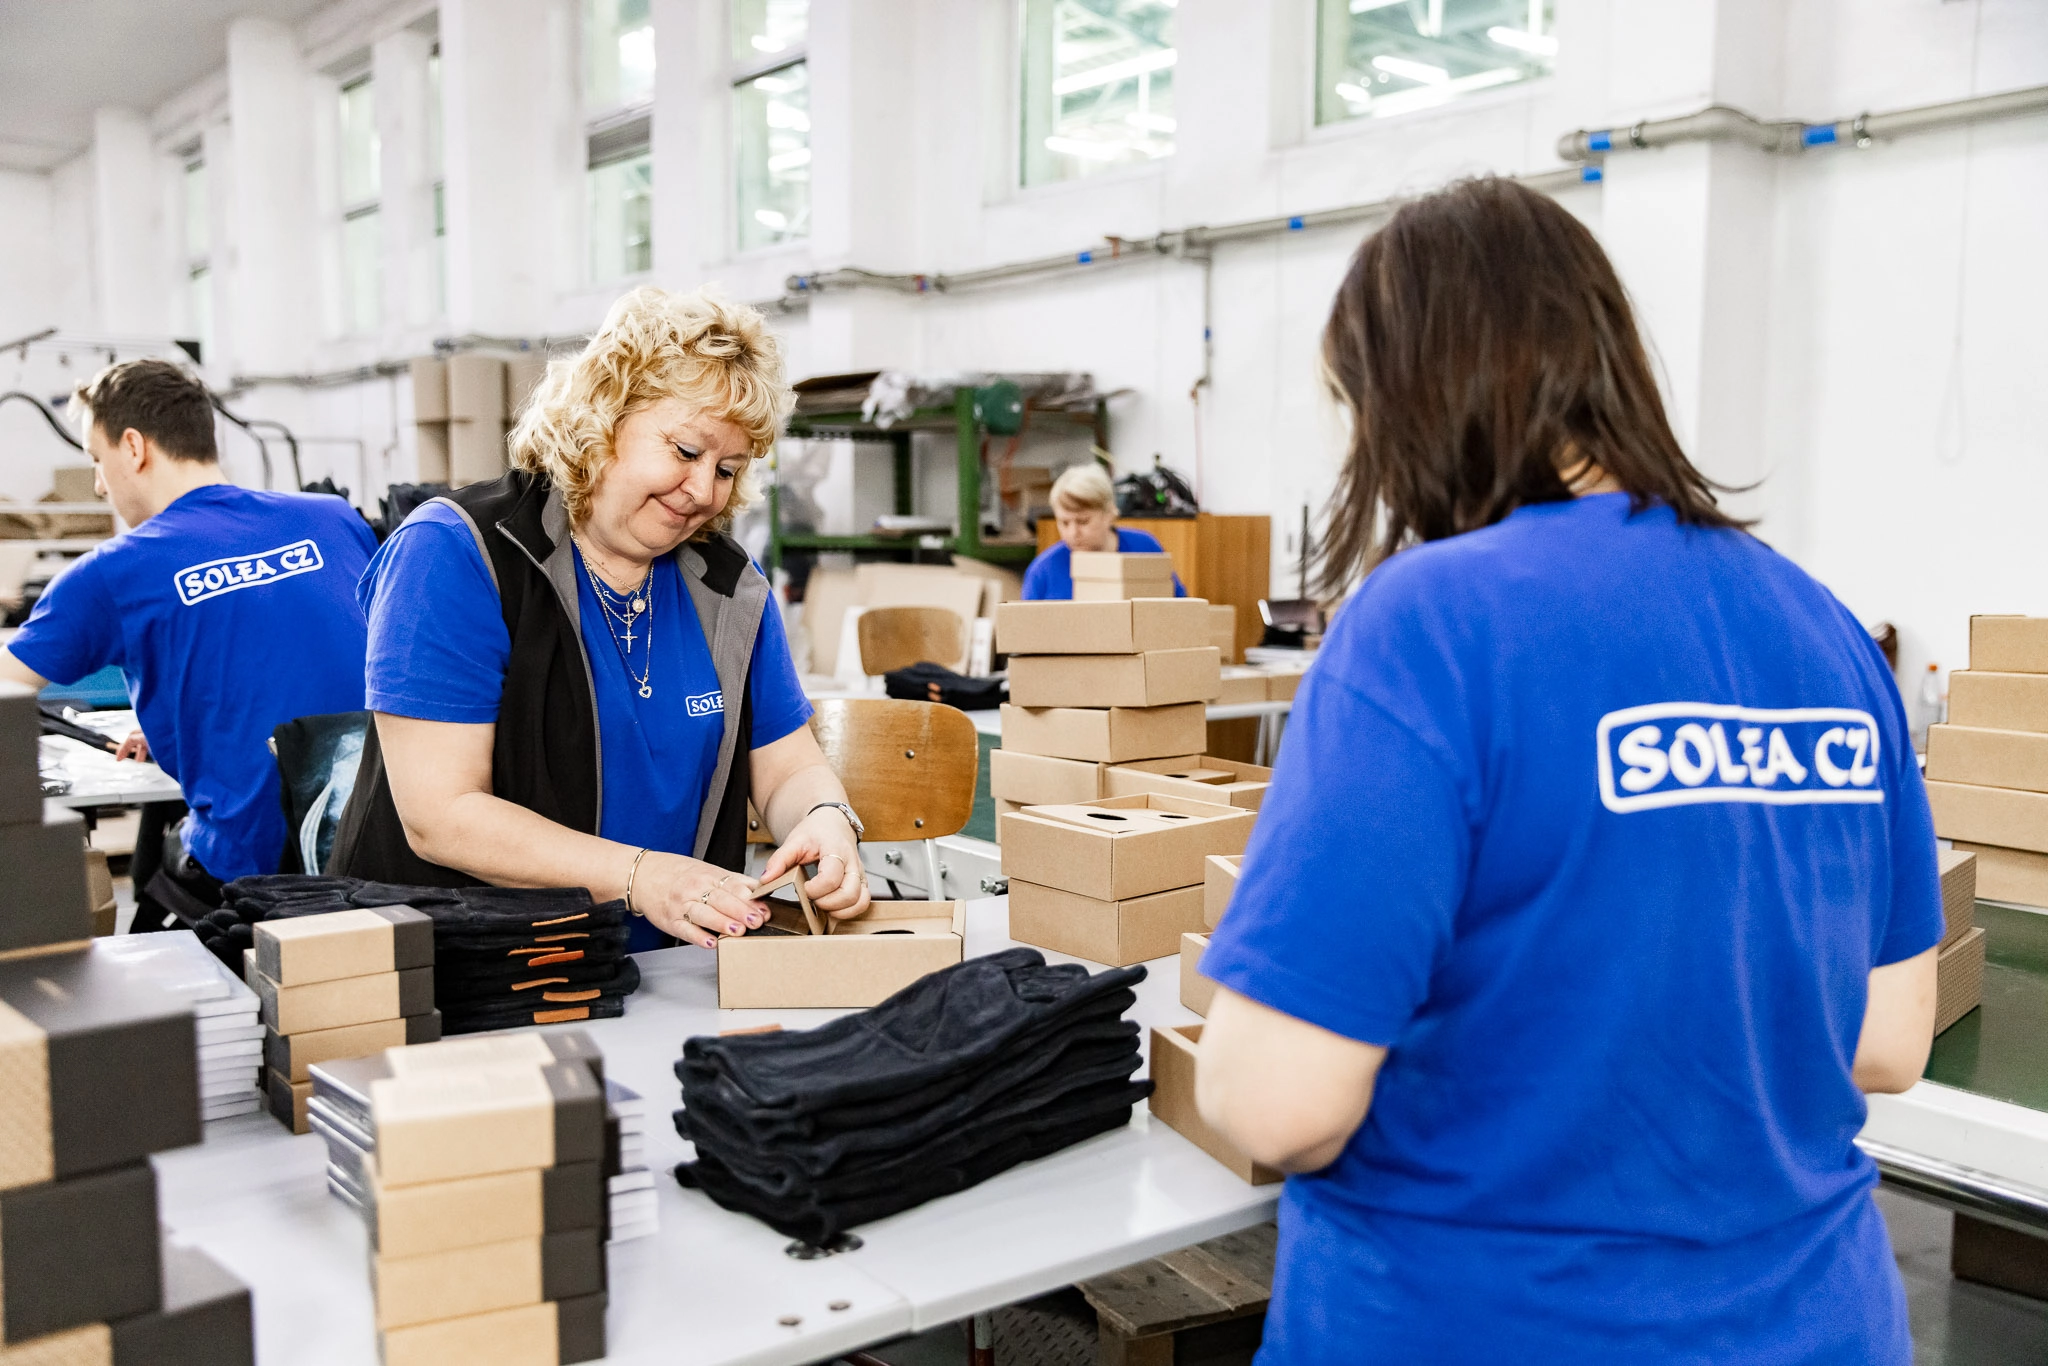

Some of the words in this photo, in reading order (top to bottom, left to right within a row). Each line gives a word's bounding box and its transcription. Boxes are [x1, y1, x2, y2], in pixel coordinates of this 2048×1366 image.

[184, 558, 278, 597] SOLEA
[280, 546, 314, 571] CZ
[1618, 722, 1808, 792] SOLEA
[1814, 727, 1877, 787] CZ
